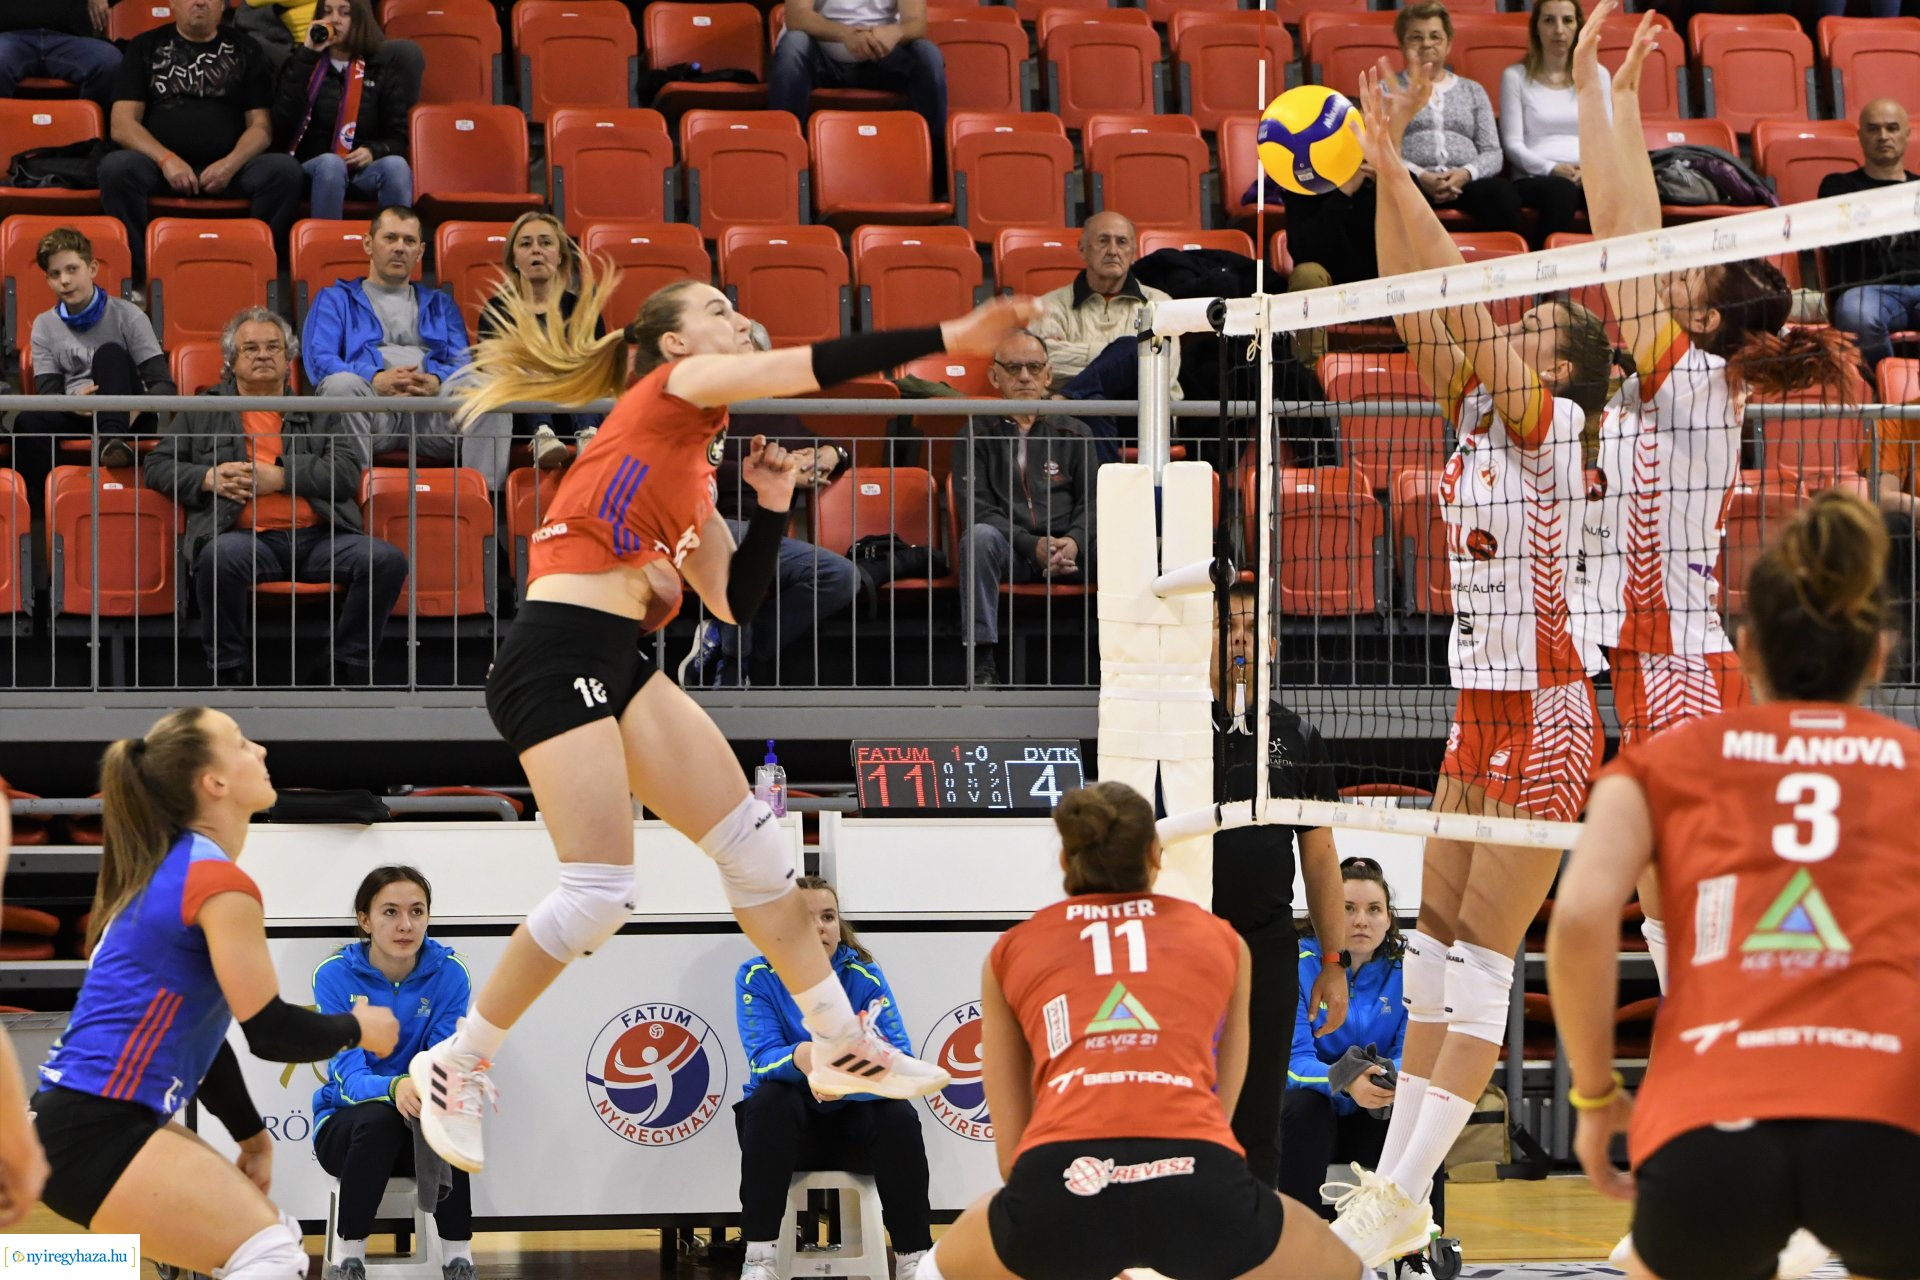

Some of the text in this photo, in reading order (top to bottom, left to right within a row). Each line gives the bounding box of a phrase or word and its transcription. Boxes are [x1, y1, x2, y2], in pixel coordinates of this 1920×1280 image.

[858, 747, 929, 762] FATUM
[1024, 747, 1080, 762] DVTK
[964, 762, 976, 774] T
[1722, 730, 1906, 770] MILANOVA
[868, 764, 927, 808] 11
[1029, 764, 1064, 807] 4
[1771, 772, 1842, 863] 3
[1066, 899, 1156, 921] PINTER
[1079, 919, 1148, 976] 11
[621, 1006, 692, 1028] FATUM
[1085, 1033, 1137, 1050] KE-VIZ
[1139, 1033, 1159, 1046] 21
[1083, 1070, 1194, 1089] BESTRONG
[596, 1094, 721, 1143] NYÍREGYHÁZA
[929, 1094, 995, 1138] NYÍREG
